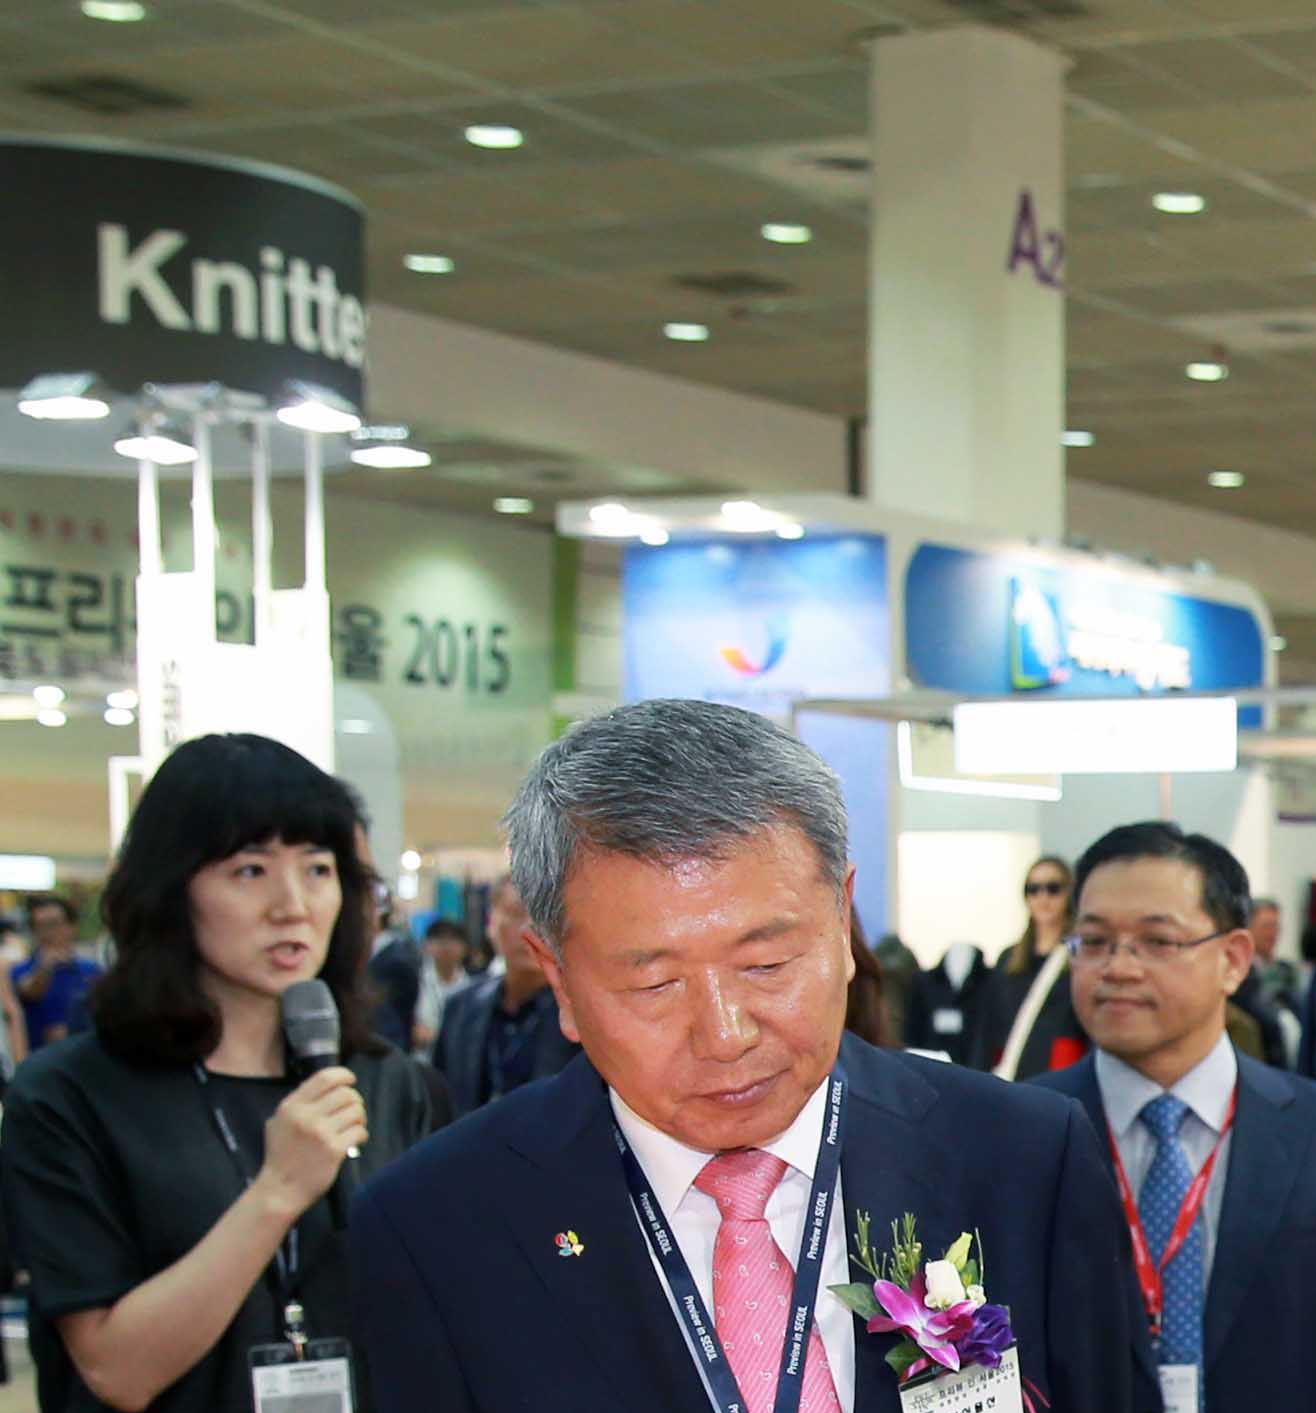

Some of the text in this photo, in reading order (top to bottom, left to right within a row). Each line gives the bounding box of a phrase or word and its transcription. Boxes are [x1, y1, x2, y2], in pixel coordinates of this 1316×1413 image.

[403, 612, 511, 693] 2015
[806, 1228, 820, 1260] Preview
[813, 1190, 828, 1219] SEOUL
[683, 1295, 702, 1329] Preview
[700, 1333, 718, 1364] SEOUL
[793, 1305, 808, 1334] SEOUL
[787, 1340, 801, 1376] Preview
